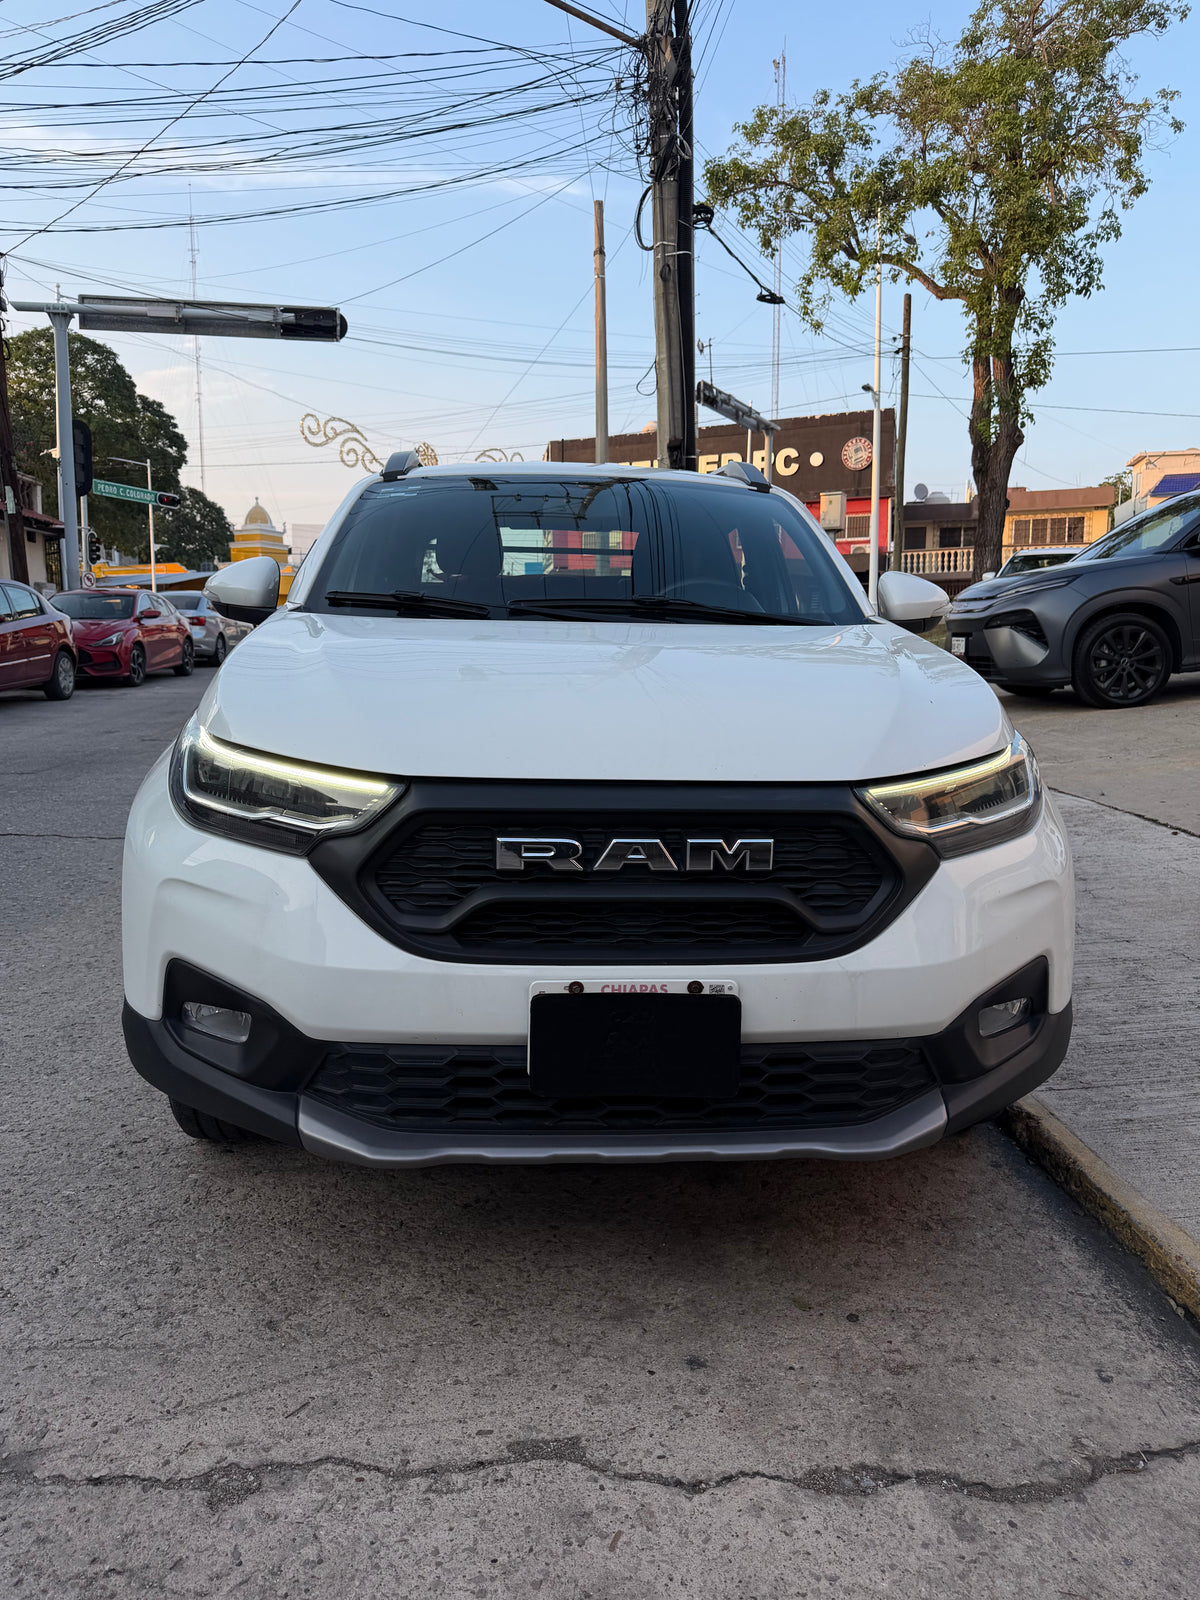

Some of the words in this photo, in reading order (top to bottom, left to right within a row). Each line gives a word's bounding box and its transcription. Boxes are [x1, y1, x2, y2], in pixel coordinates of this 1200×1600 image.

[97, 483, 117, 494] PEDRO
[119, 488, 126, 496] C.
[126, 489, 155, 501] COLORADO
[496, 837, 774, 871] RAM
[600, 984, 669, 994] CHIAPAS
